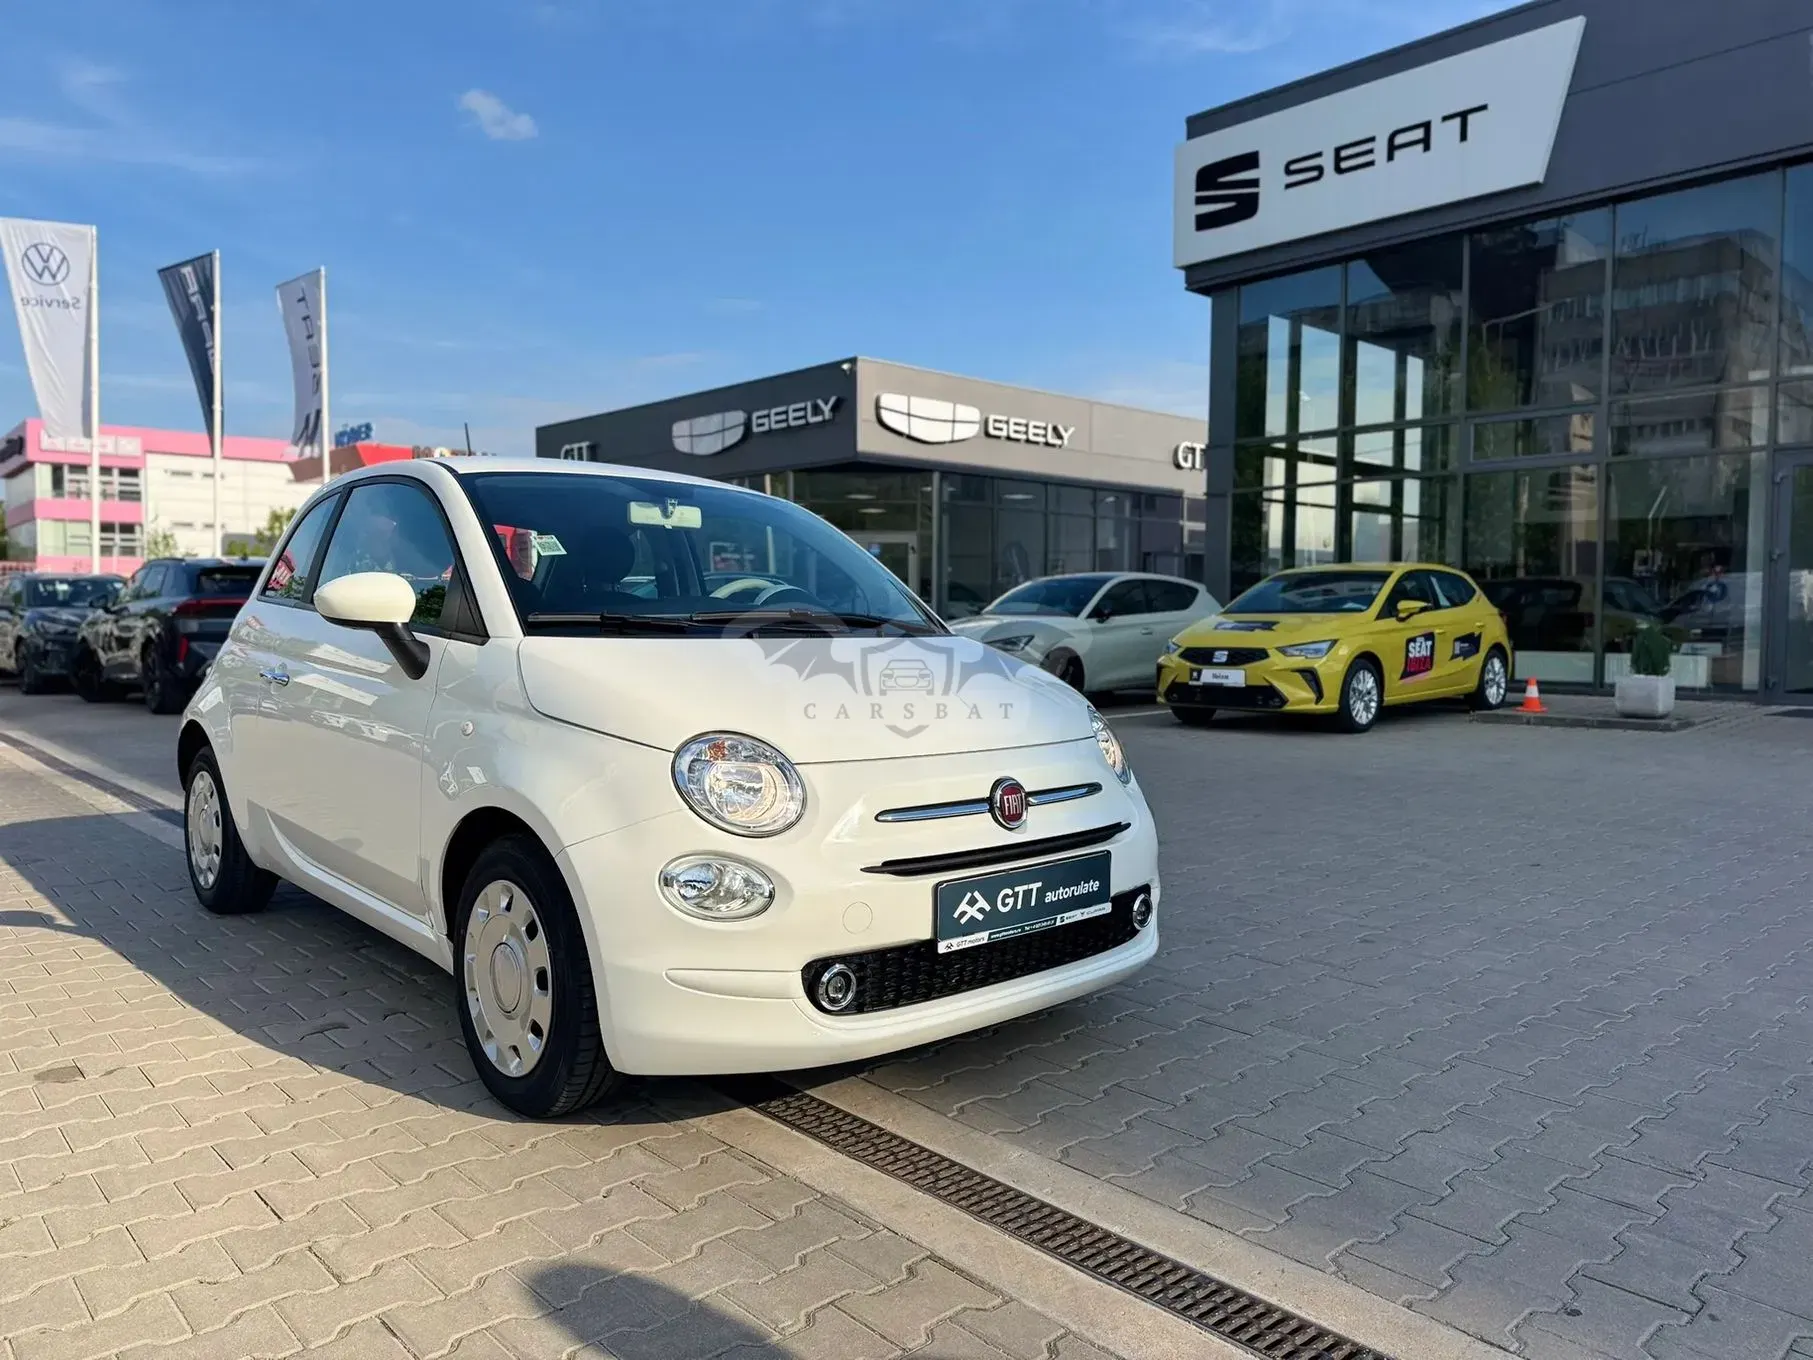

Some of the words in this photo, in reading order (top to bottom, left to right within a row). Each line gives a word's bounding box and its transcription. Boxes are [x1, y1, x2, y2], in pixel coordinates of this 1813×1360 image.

[1284, 103, 1488, 190] SEAT
[752, 396, 837, 433] GEELY
[987, 414, 1076, 448] GEELY
[1178, 441, 1206, 469] GT
[1408, 640, 1433, 658] SEAT
[1003, 793, 1025, 816] FIAT
[997, 882, 1042, 913] GTT
[1044, 879, 1100, 903] autorulate
